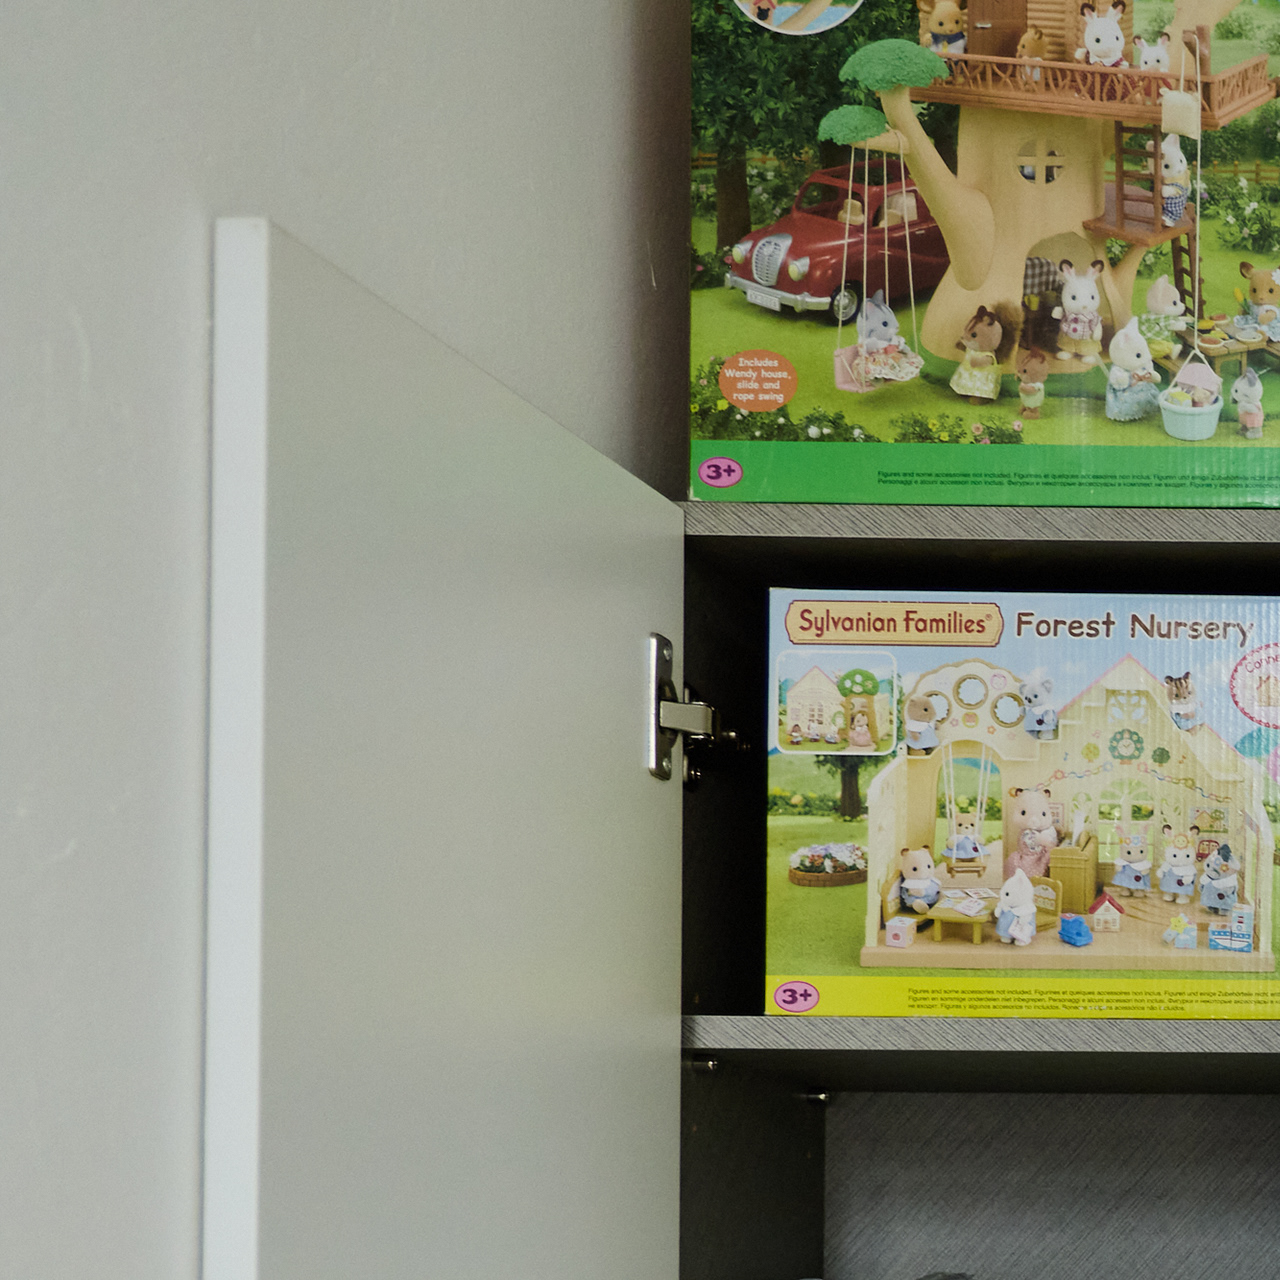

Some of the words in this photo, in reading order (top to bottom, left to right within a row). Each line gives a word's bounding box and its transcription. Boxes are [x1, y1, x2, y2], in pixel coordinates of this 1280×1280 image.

[738, 357, 778, 367] Includes
[724, 369, 757, 380] Wendy
[737, 380, 759, 389] slide
[763, 380, 780, 389] and
[733, 392, 754, 402] rope
[758, 392, 784, 403] swing
[706, 464, 736, 480] 3+
[799, 608, 897, 638] Sylvanian
[1016, 611, 1116, 639] Forest
[1130, 613, 1254, 648] Nursery
[782, 988, 812, 1005] 3+
